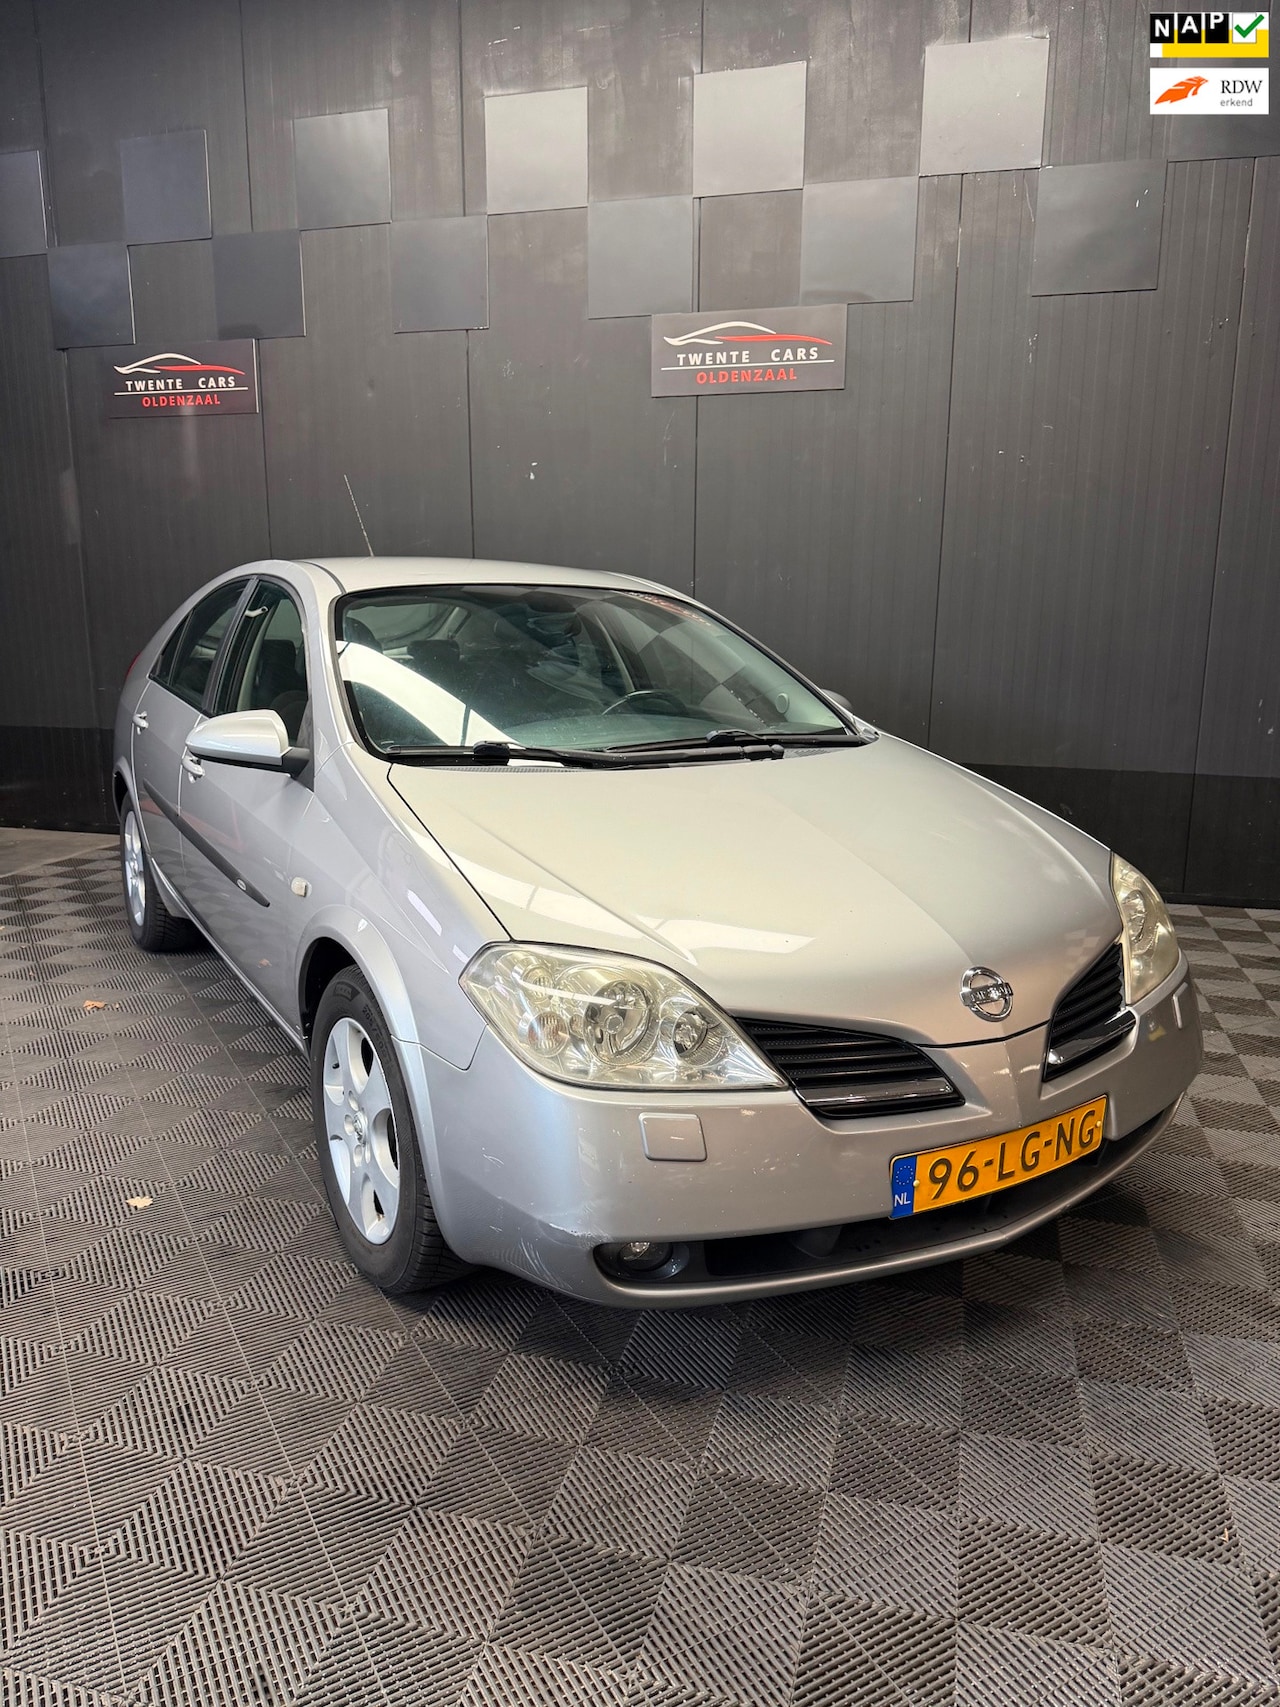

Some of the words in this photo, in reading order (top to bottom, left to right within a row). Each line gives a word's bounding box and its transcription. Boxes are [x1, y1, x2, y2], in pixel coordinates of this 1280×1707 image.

[677, 350, 750, 366] TWENTE
[771, 347, 818, 362] CARS
[696, 367, 797, 384] OLDENZAAL
[125, 378, 183, 392] TWENTE
[198, 376, 236, 389] CARS
[142, 394, 221, 408] OLDENZAAL
[928, 1109, 1096, 1200] 96-LG-NG
[894, 1192, 911, 1207] NL
